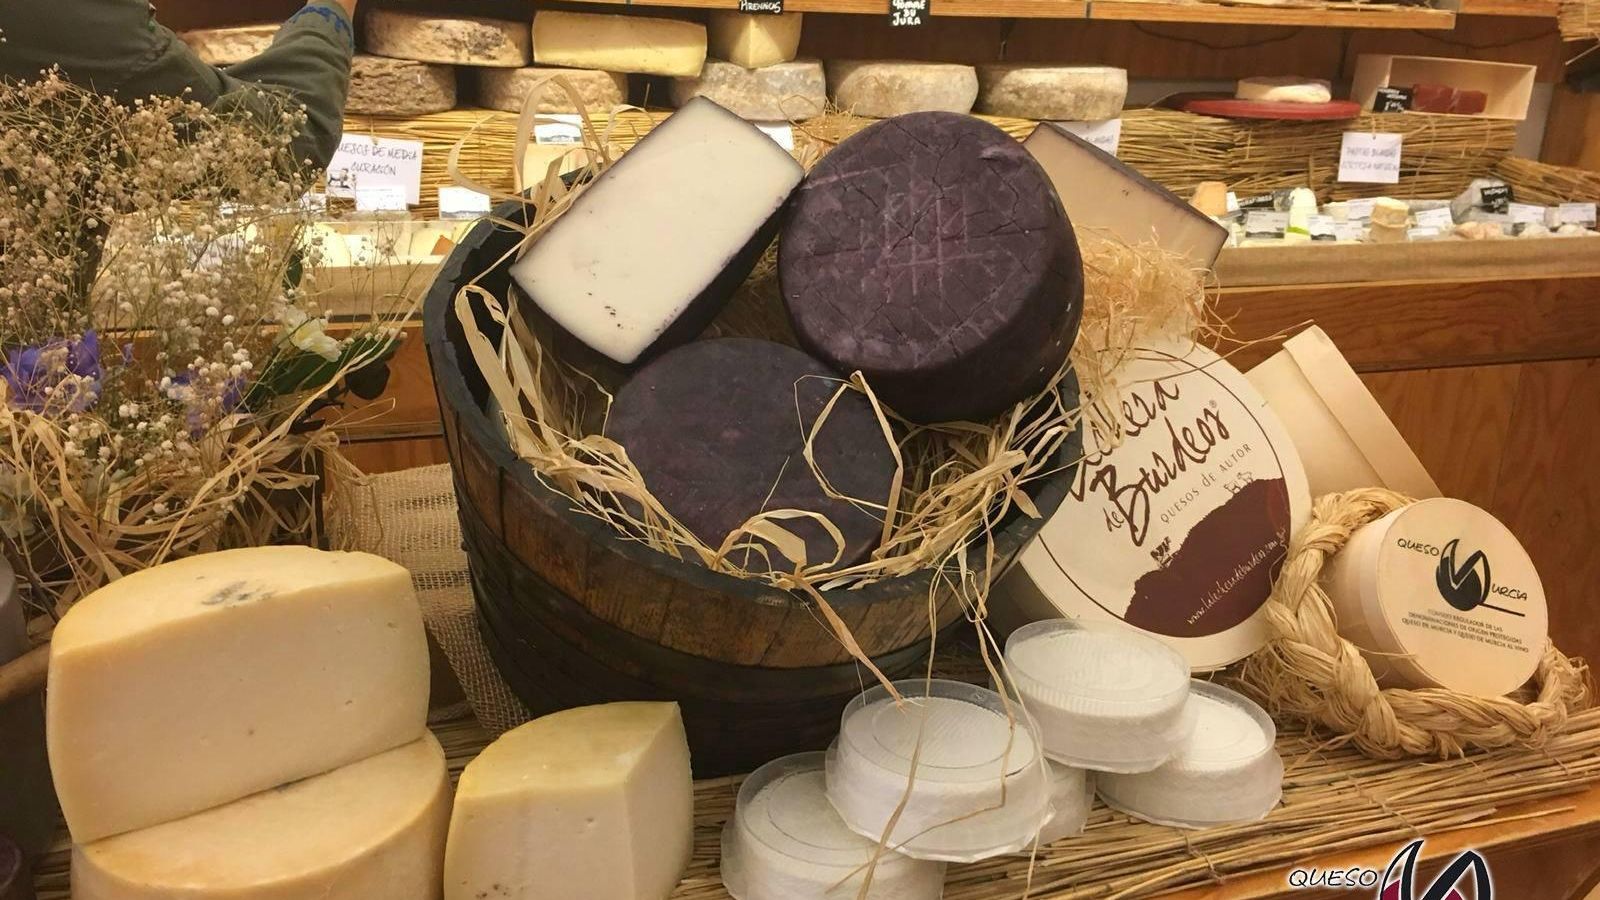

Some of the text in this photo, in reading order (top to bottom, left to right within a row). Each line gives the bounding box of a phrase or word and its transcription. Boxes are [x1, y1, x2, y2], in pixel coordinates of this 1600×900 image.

[892, 12, 921, 26] JURA
[338, 142, 370, 156] UESOS
[372, 145, 386, 158] DE
[1090, 406, 1230, 547] Burdeos
[1160, 487, 1200, 524] QUESOS
[1219, 443, 1252, 474] AUTOR
[1397, 538, 1440, 557] QUESO
